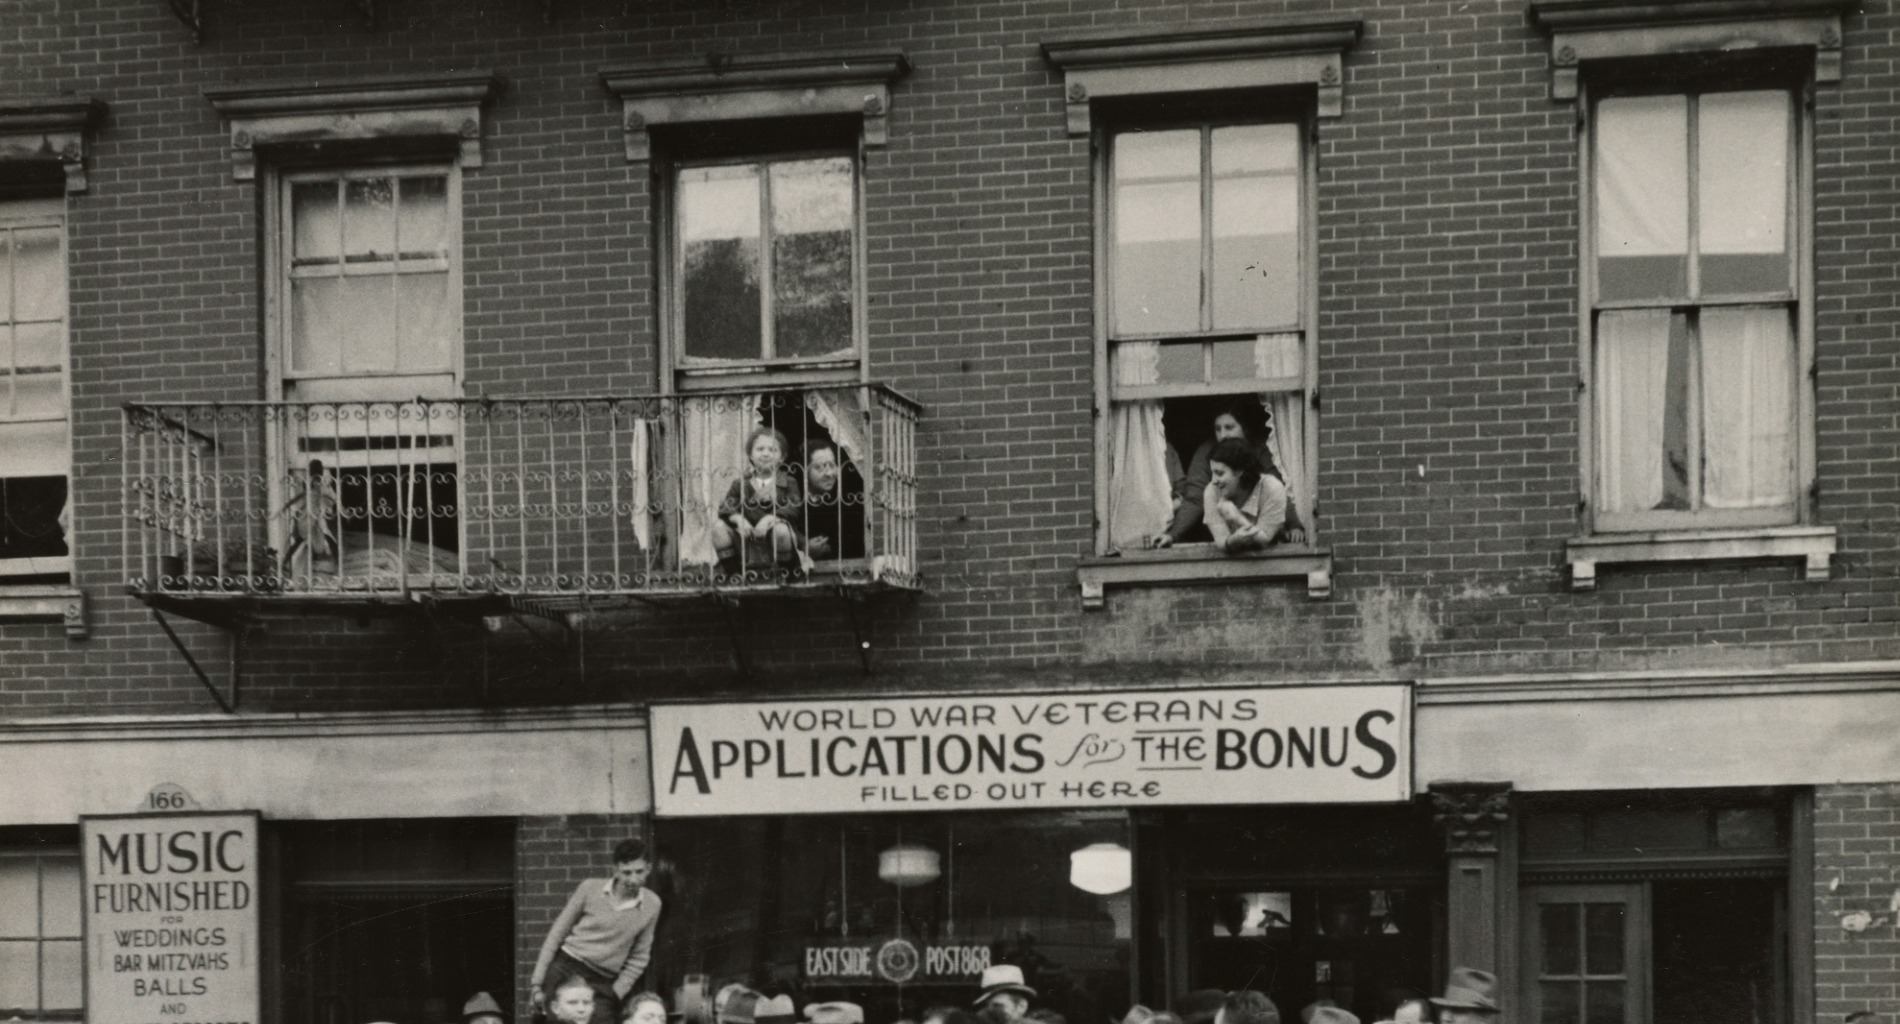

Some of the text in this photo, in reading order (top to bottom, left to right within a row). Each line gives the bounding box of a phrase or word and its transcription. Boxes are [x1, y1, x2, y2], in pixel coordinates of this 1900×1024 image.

[759, 698, 1258, 732] WORLD WAR VETERANS
[1054, 732, 1126, 769] for
[1131, 735, 1207, 762] THE
[1215, 709, 1398, 780] BONUS
[149, 792, 185, 810] 166
[860, 780, 1162, 802] FILLED OUT HERE
[96, 829, 246, 876] MUSIC
[93, 880, 251, 914] FURNISHED
[114, 927, 227, 948] WEDDINGS
[113, 952, 229, 974] BAR MITZVAHS
[806, 945, 992, 977] EAST SIDE POST 868
[133, 976, 208, 997] BALLS
[159, 1002, 187, 1015] AND
